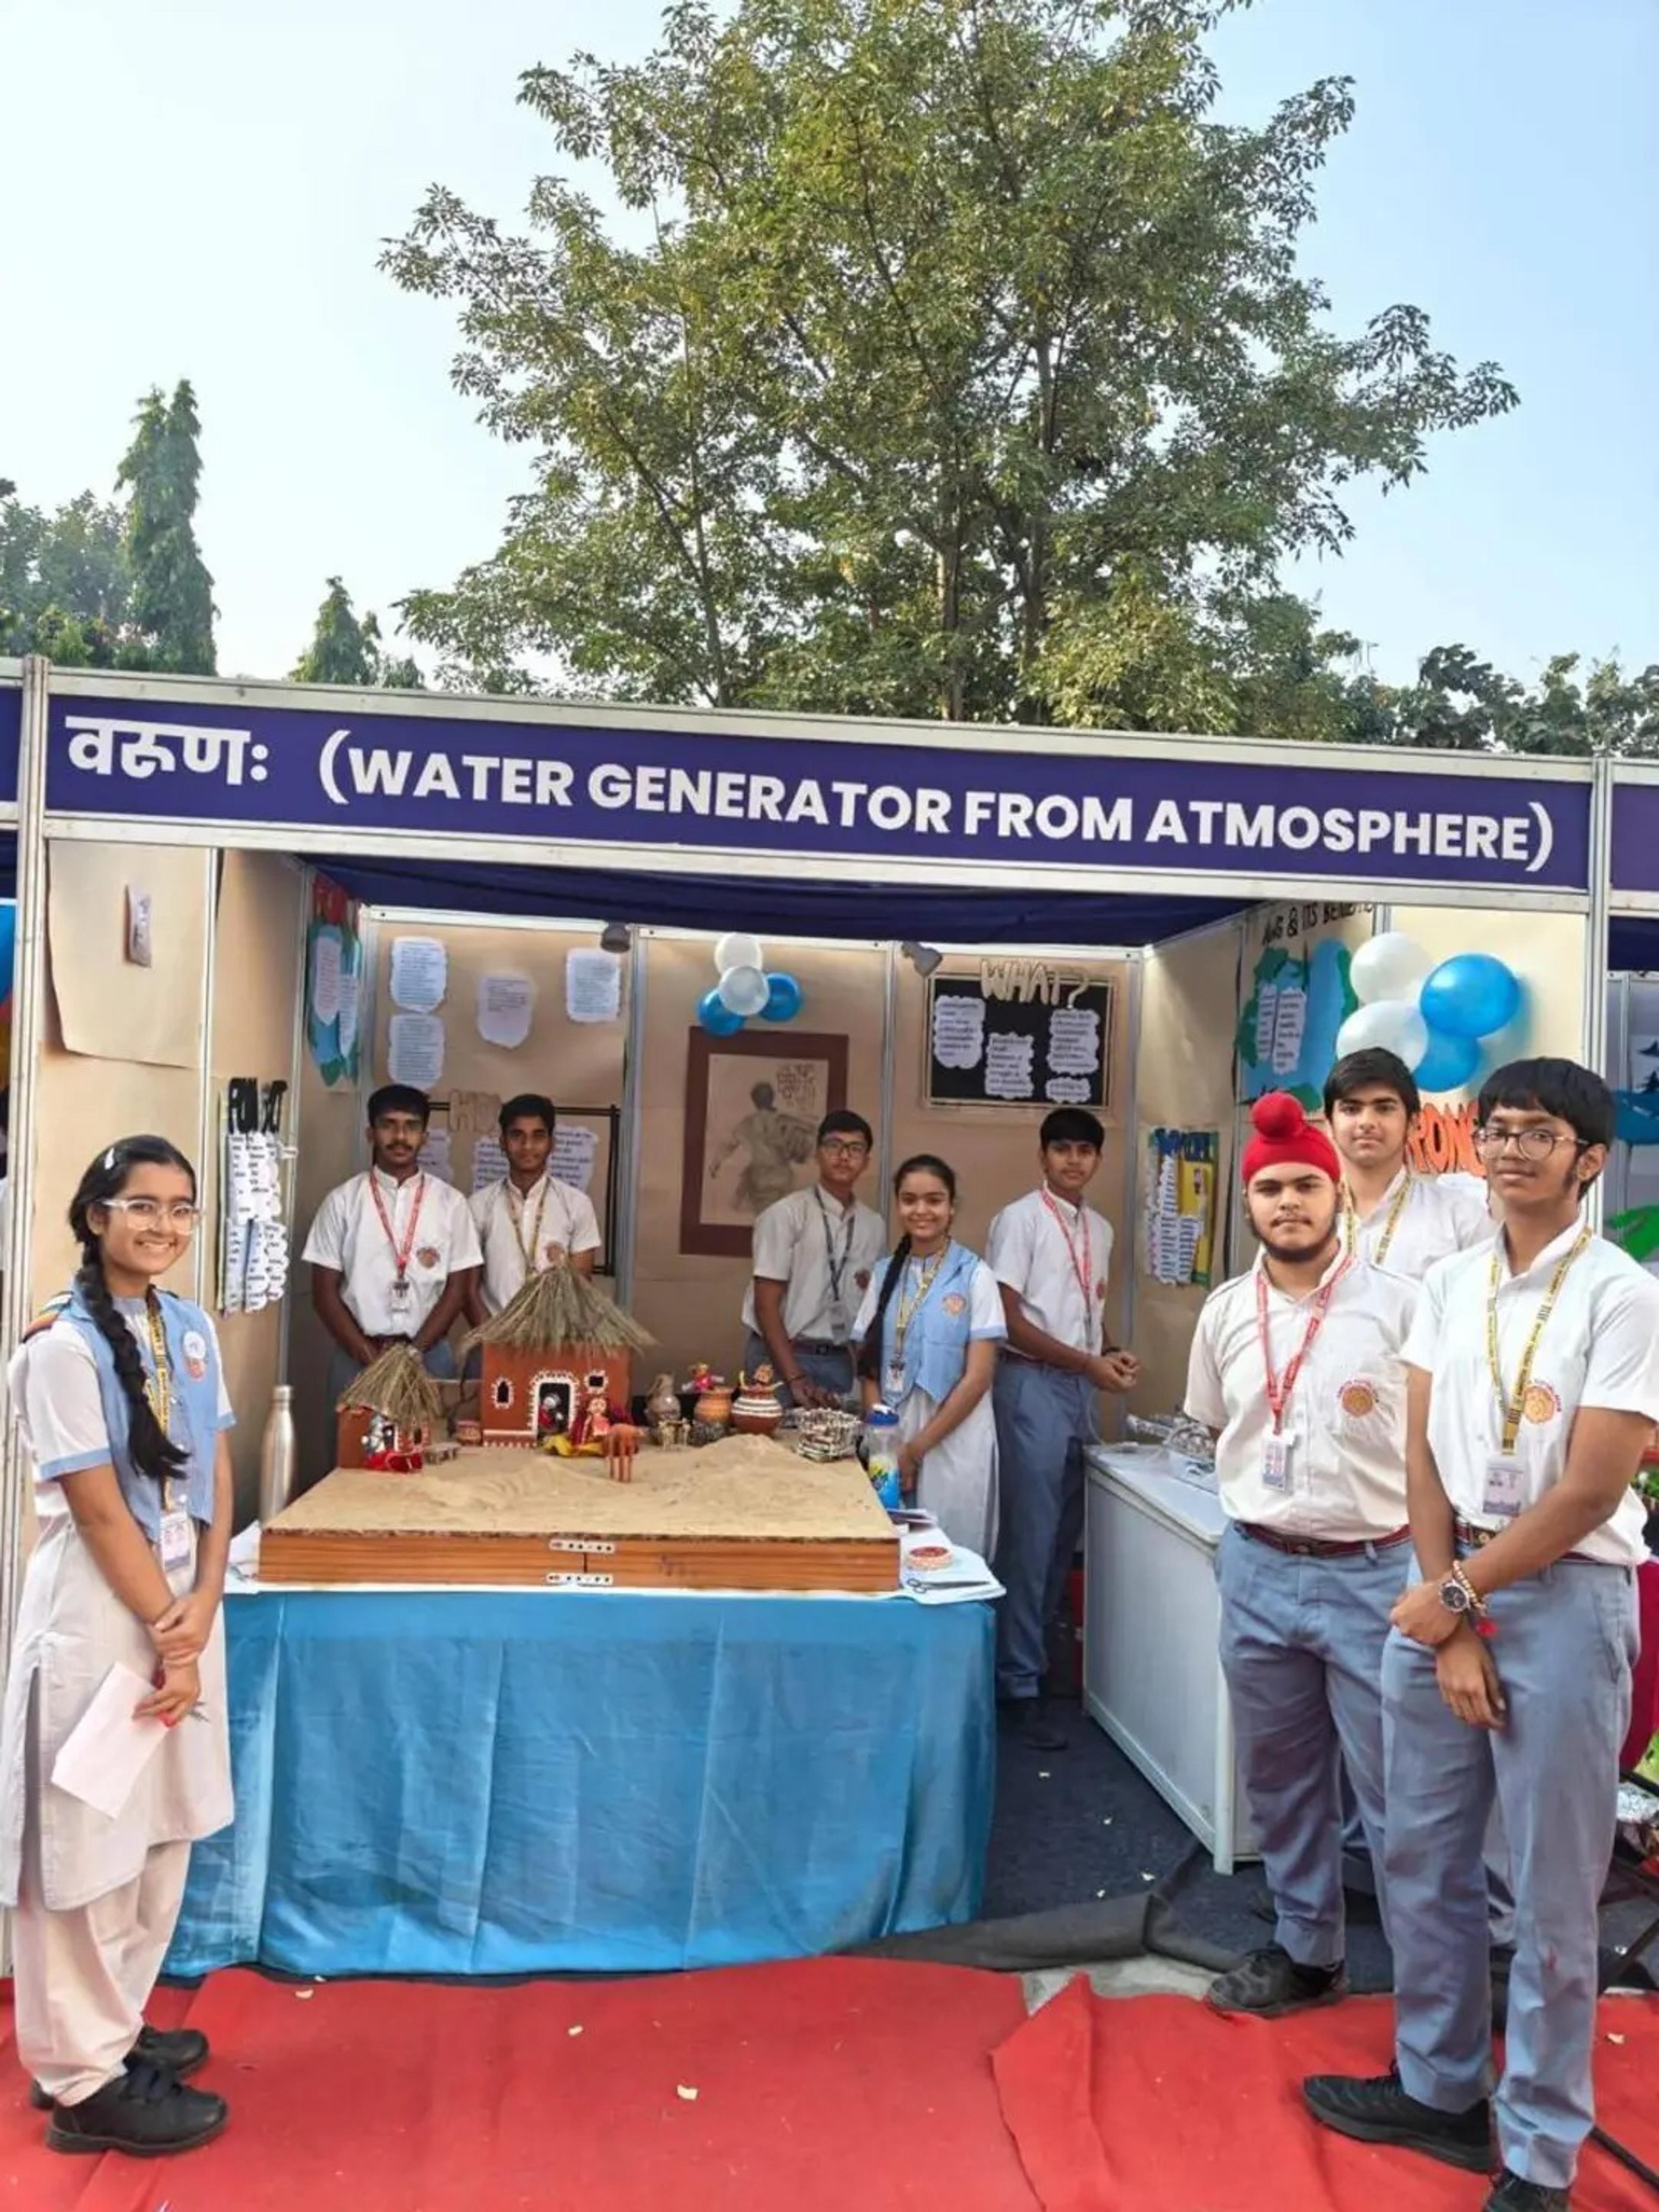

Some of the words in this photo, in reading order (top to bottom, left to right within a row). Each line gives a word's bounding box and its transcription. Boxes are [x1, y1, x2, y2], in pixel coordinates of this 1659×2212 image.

[320, 729, 574, 805] (WATER
[588, 764, 951, 833] GENERATOR
[965, 791, 1132, 841] FROM
[1145, 800, 1552, 872] ATMOSPHERE)
[980, 959, 1090, 1009] WHAT?
